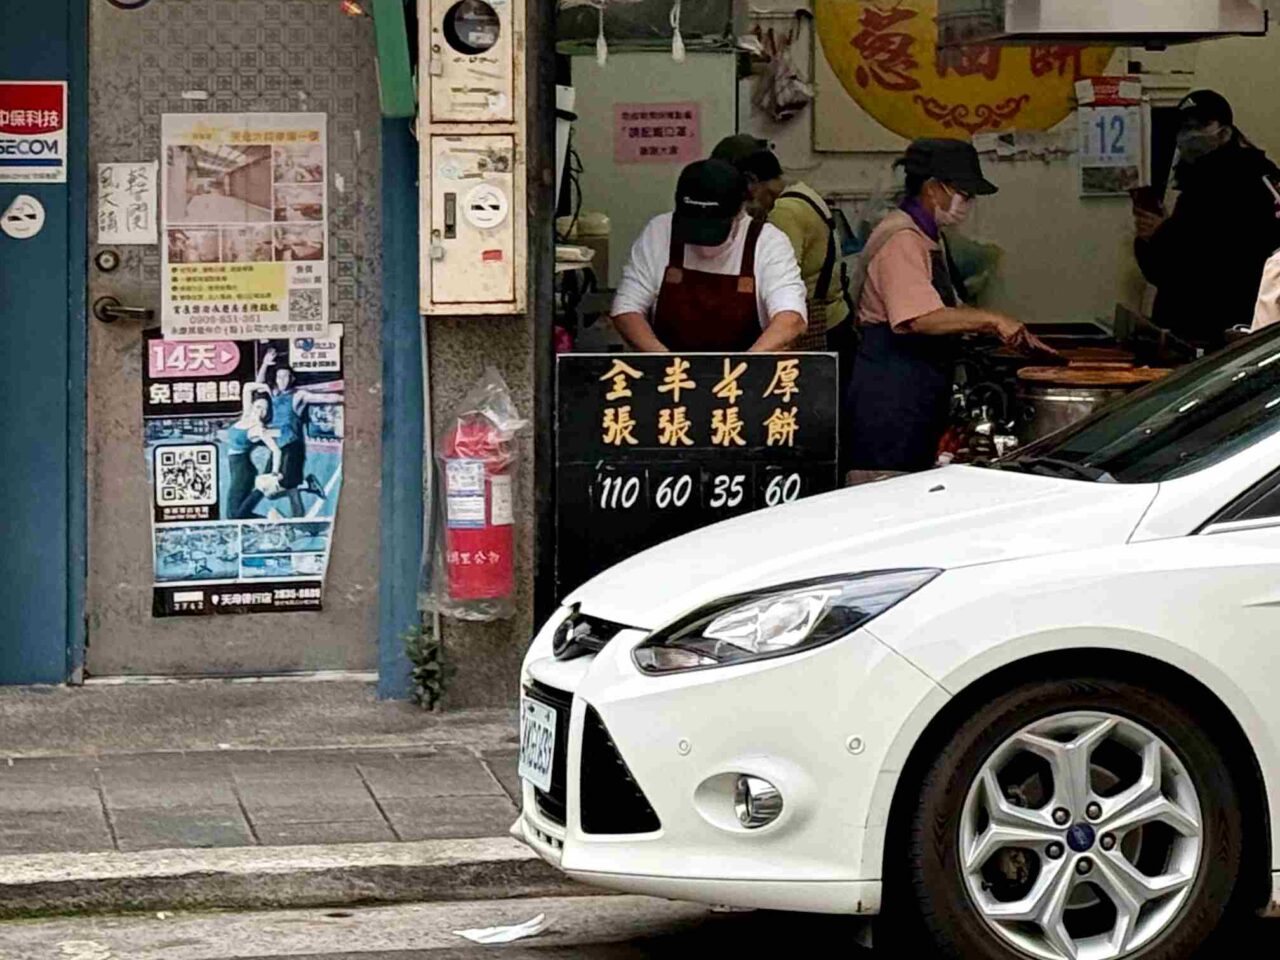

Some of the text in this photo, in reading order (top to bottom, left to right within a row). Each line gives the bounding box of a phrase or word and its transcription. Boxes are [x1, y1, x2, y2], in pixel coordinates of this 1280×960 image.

[1095, 114, 1125, 155] 12
[152, 344, 217, 372] 14天
[149, 380, 241, 405] 免費體驗
[599, 358, 644, 446] 全張
[657, 356, 696, 446] 半張
[762, 359, 800, 447] 厚餅
[599, 473, 801, 509] 110 60 35 60
